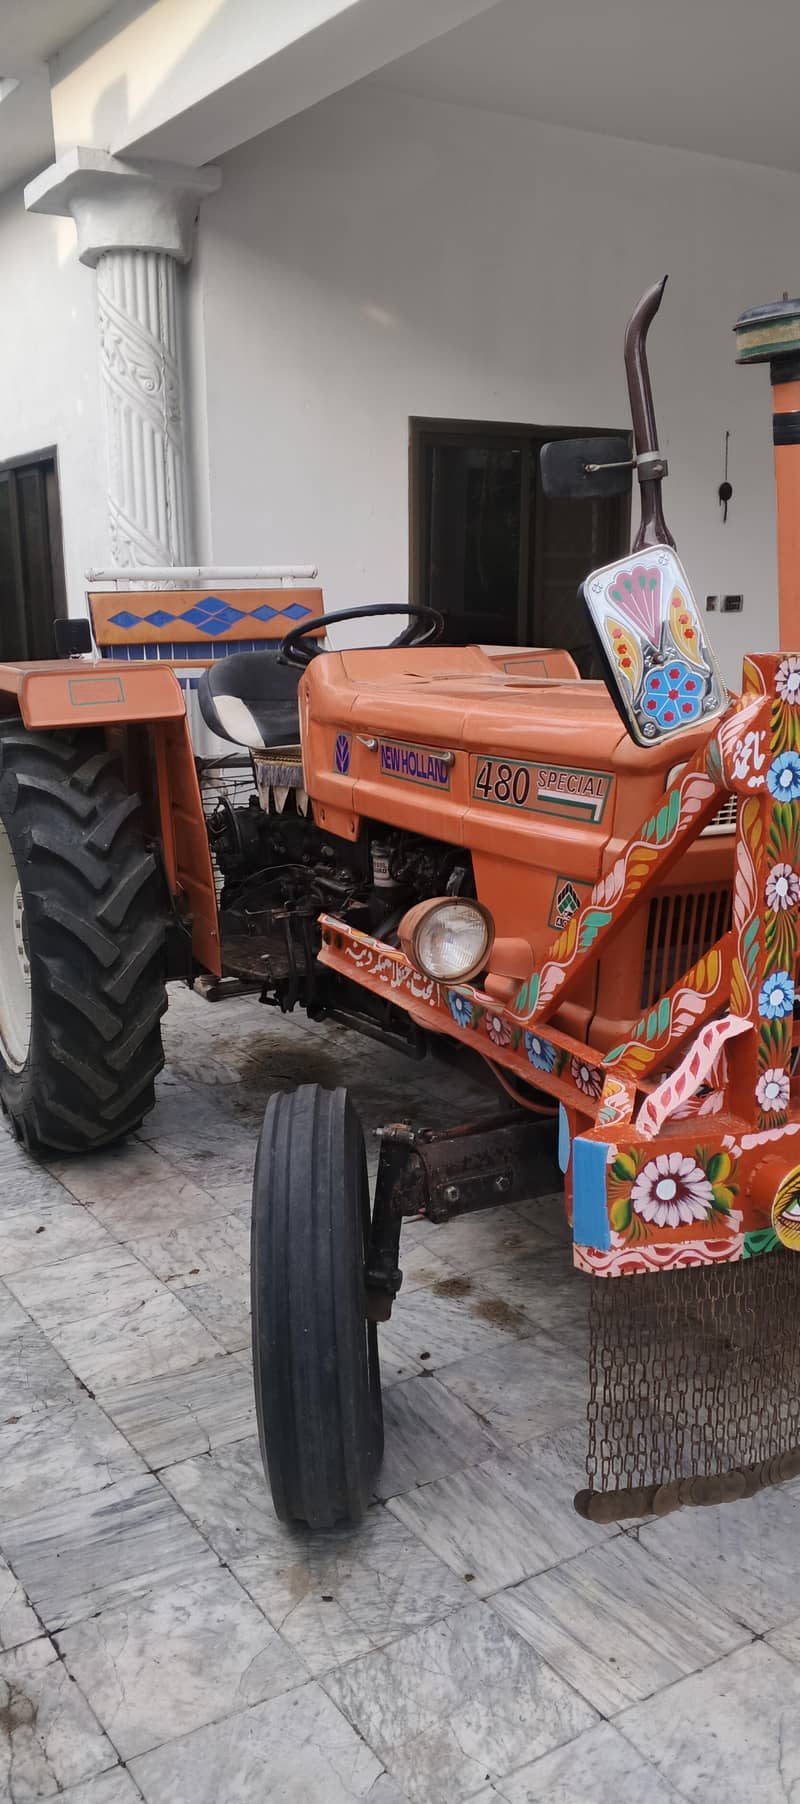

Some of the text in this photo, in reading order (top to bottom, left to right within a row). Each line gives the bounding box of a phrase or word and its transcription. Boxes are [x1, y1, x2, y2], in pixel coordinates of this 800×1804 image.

[381, 744, 449, 784] NEW HOLLAND
[475, 761, 604, 805] 480 SPECIAL
